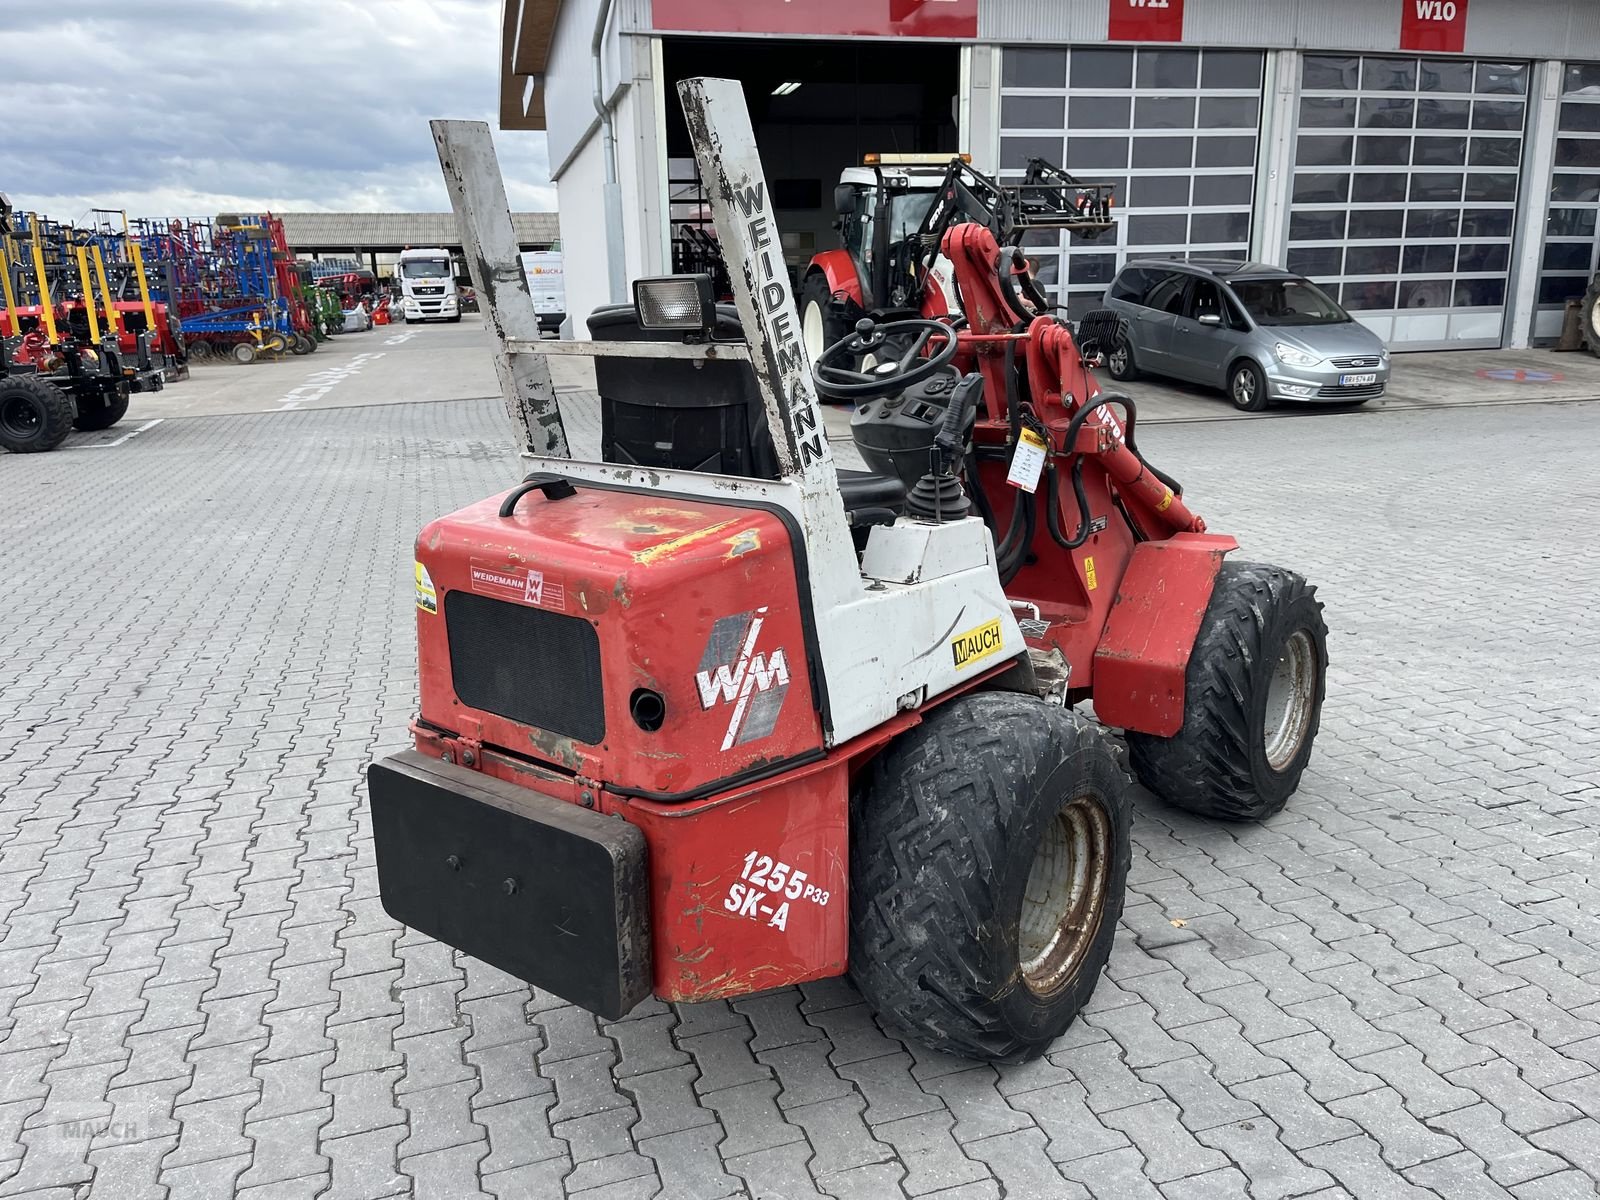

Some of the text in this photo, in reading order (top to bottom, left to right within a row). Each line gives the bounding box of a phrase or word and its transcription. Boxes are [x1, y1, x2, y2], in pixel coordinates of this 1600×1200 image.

[1416, 0, 1456, 21] W10
[735, 181, 824, 468] WEIDEMANN
[473, 570, 524, 589] WEIDEMANN
[951, 625, 1001, 667] MAUCH
[740, 850, 830, 906] 1255 P33
[724, 883, 790, 932] SK-A
